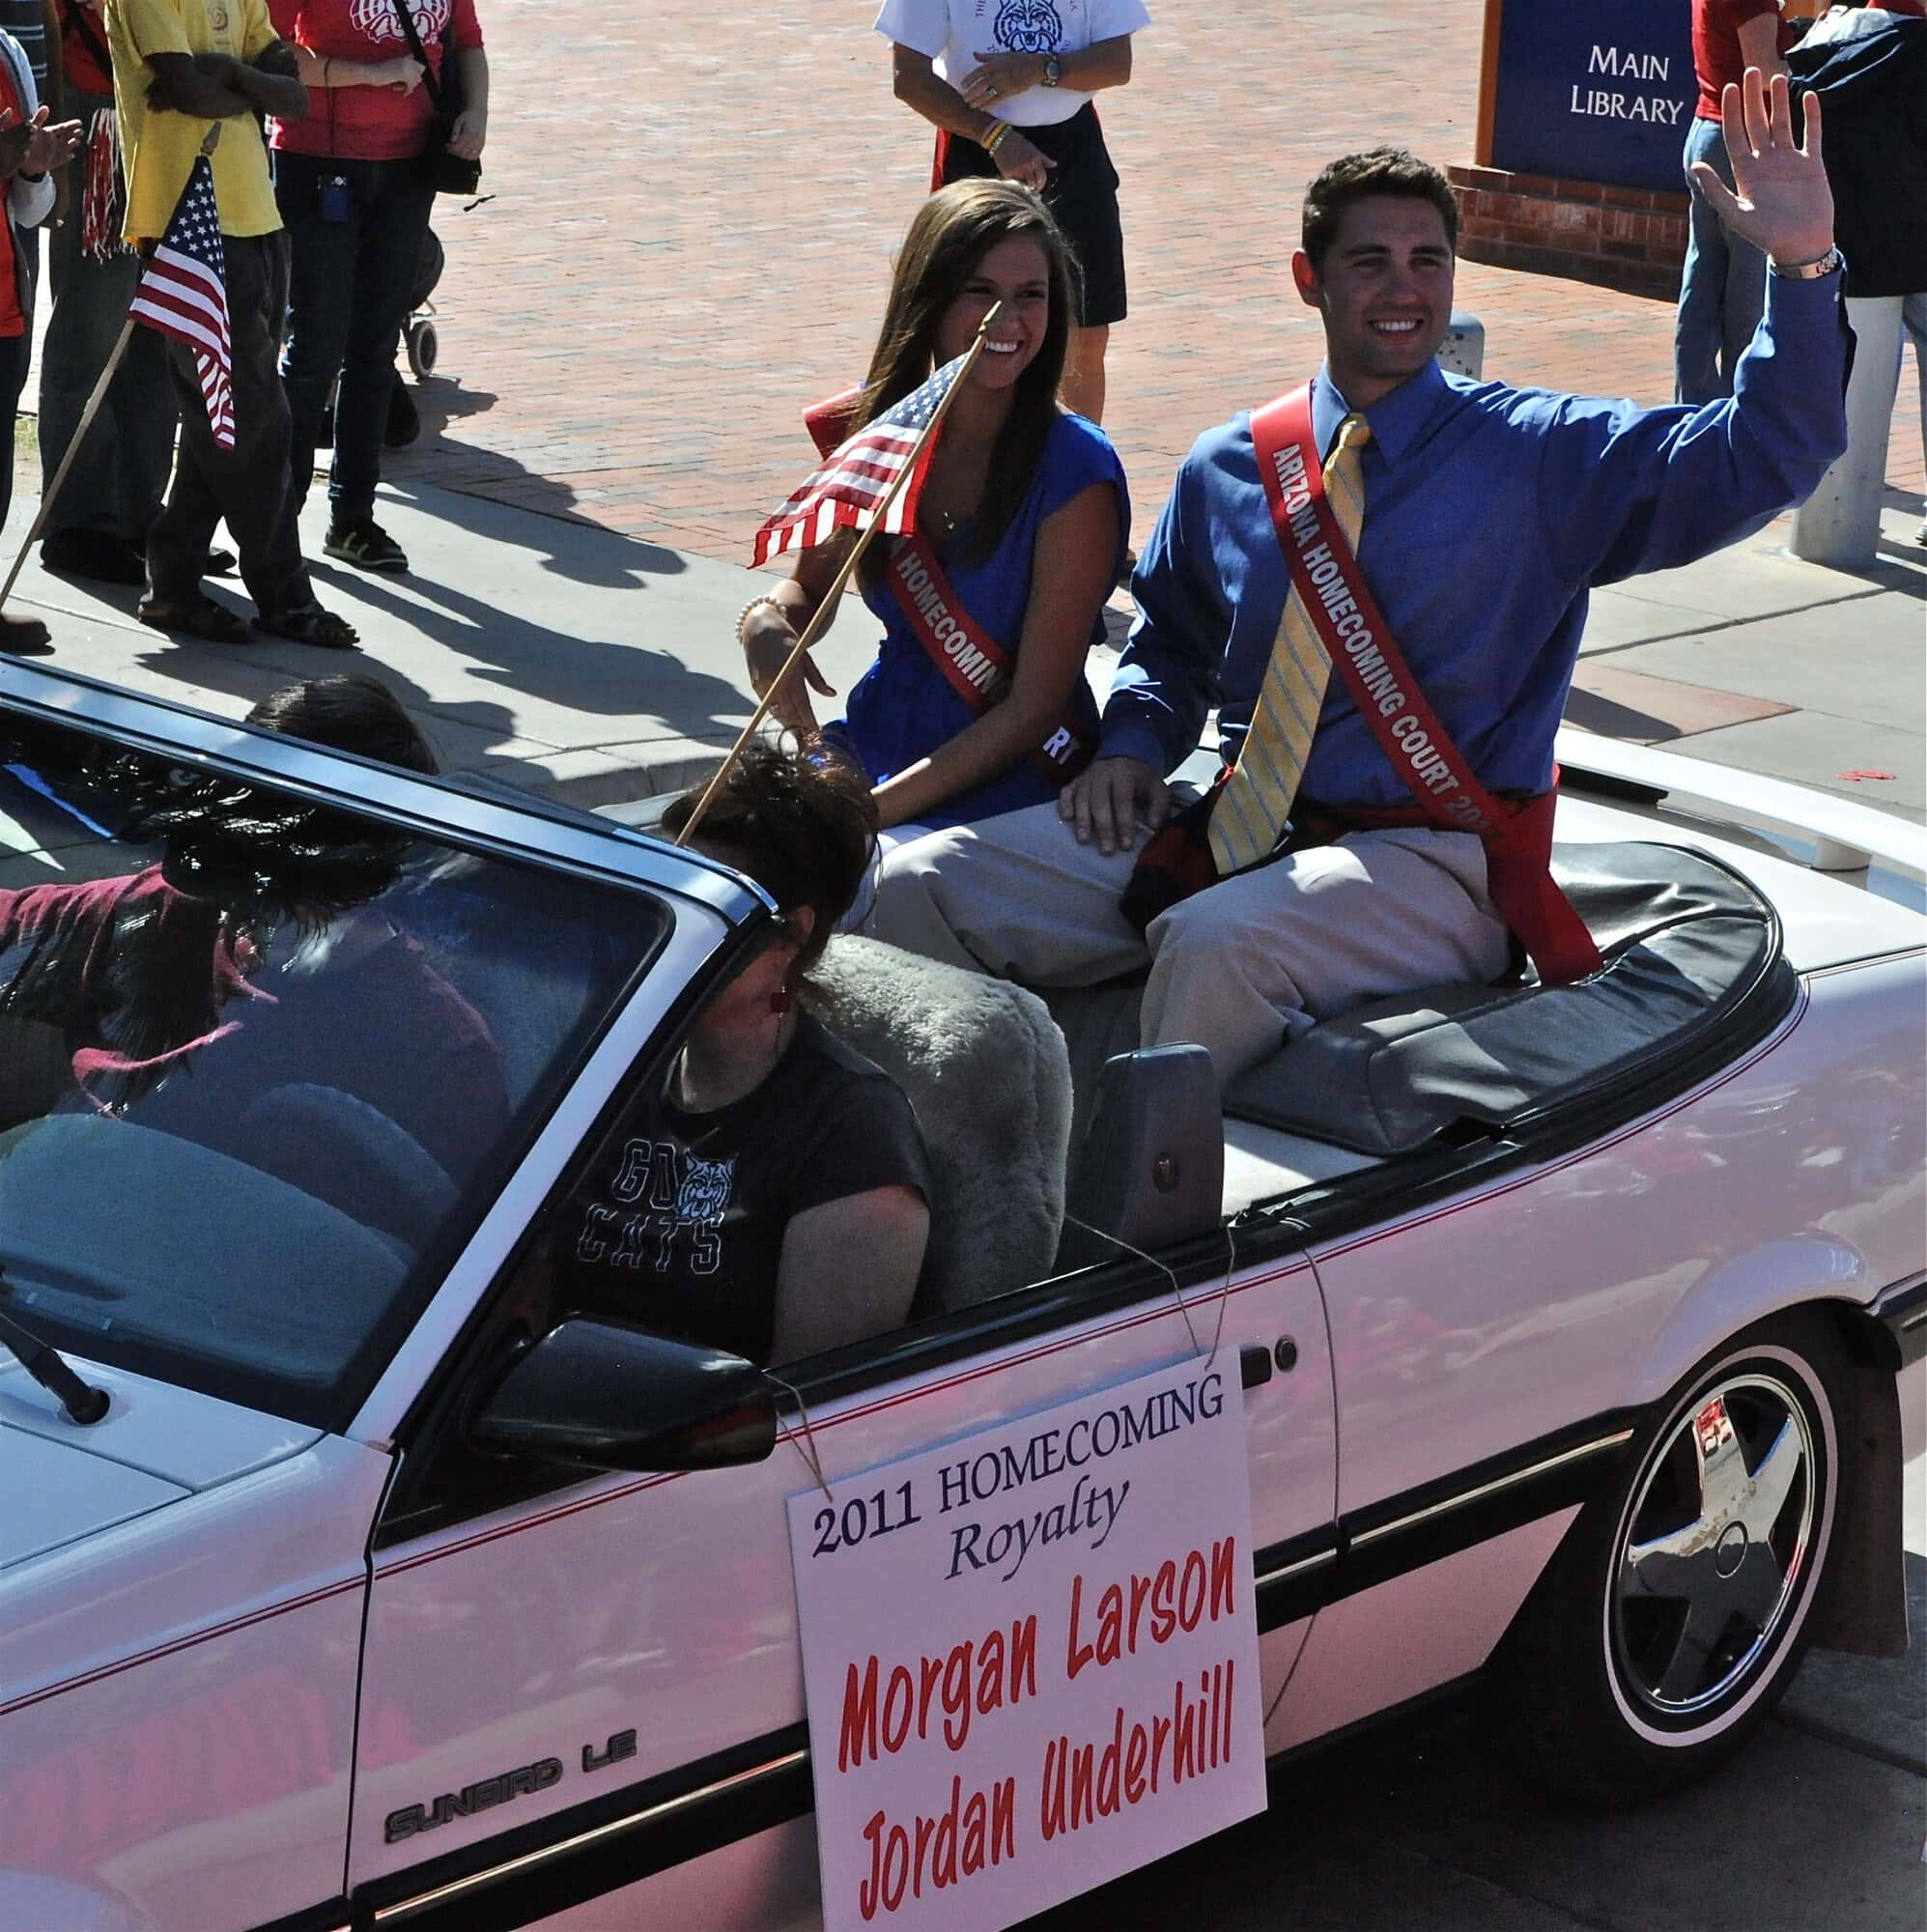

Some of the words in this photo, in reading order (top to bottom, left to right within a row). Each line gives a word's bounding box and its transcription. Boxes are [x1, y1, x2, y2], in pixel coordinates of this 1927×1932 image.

[1571, 84, 1684, 125] LIBRARY
[1588, 44, 1669, 81] MAIN
[896, 552, 1002, 696] HOMECOMIN
[1272, 443, 1320, 548] ARIZONA
[1302, 541, 1406, 718] HOMECOMING
[1391, 715, 1459, 796] COURT
[812, 1480, 921, 1557] 2011
[939, 1374, 1224, 1513] HOMECOMING
[944, 1474, 1131, 1582] Royalty
[837, 1614, 1037, 1774] Morgan
[1067, 1536, 1235, 1680] Larson
[384, 1756, 564, 1844] SUNBIRD
[581, 1728, 638, 1773] LE
[859, 1775, 1015, 1921] Jordan
[1040, 1659, 1234, 1842] Underhill
